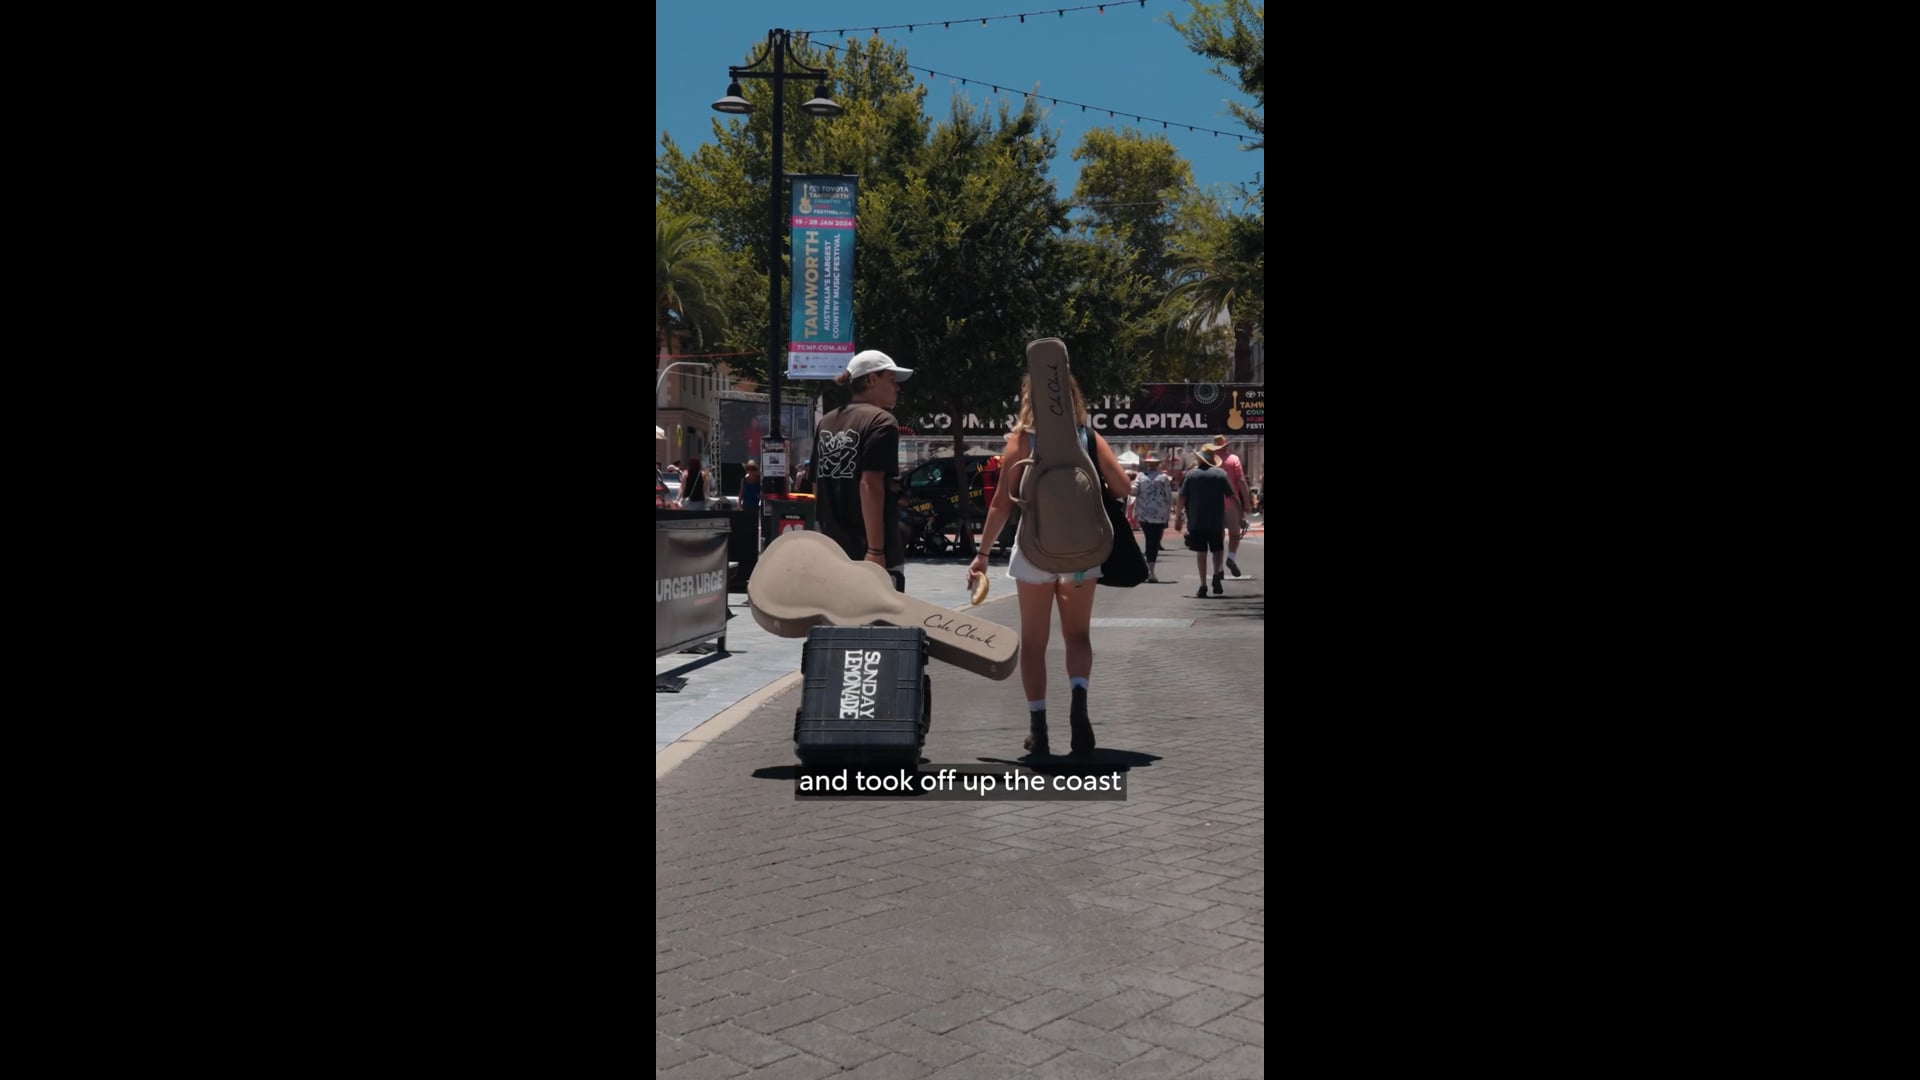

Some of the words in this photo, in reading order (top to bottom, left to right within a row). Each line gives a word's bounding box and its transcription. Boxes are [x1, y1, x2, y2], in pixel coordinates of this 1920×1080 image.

[824, 240, 832, 278] LARGEST
[833, 233, 841, 271] FESTIVAL
[804, 230, 819, 339] TAMWORTH
[823, 279, 831, 332] AUSTRALIA'S
[832, 299, 840, 339] COUNTRY
[1113, 412, 1208, 430] CAPITAL
[696, 569, 724, 595] URGE
[923, 613, 954, 632] Cole
[954, 623, 997, 649] Clark
[839, 649, 863, 720] LEMONADE
[860, 650, 881, 719] SUNDAY
